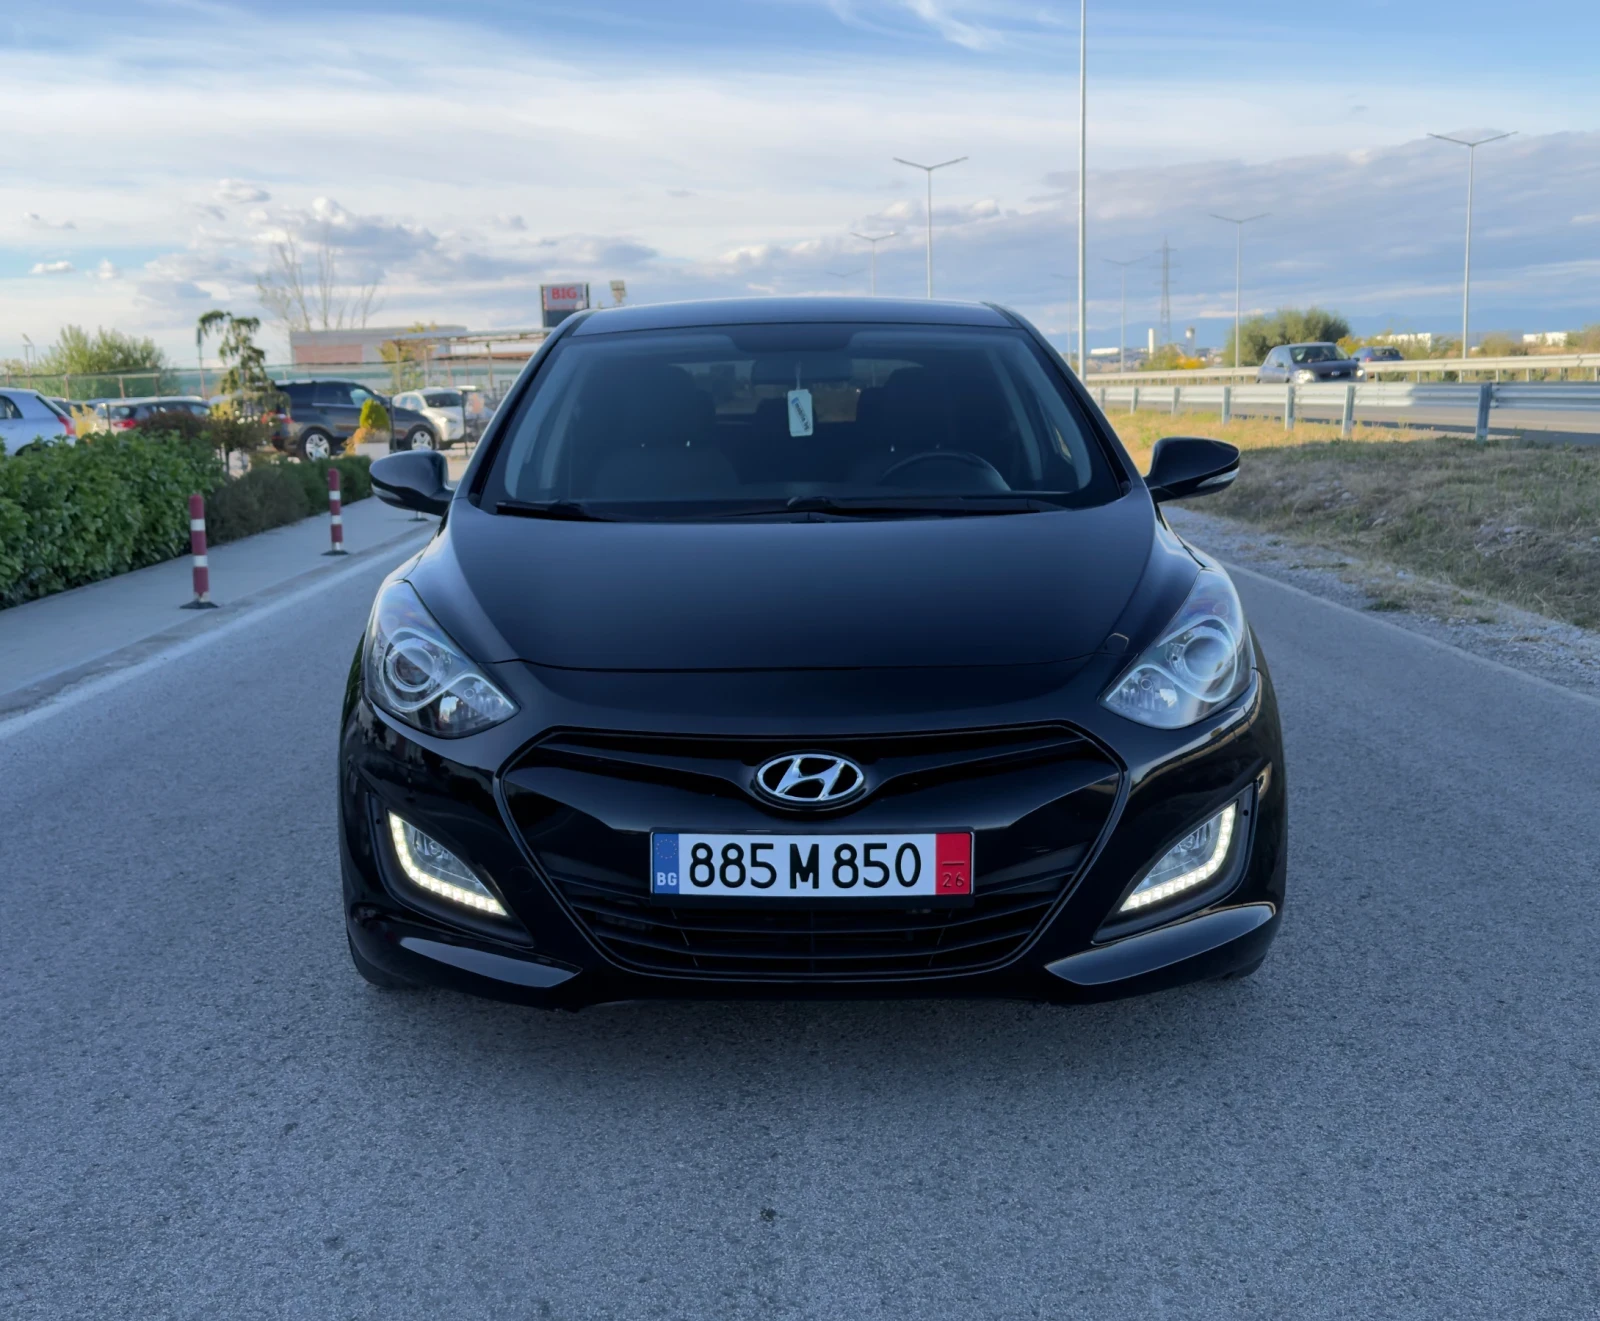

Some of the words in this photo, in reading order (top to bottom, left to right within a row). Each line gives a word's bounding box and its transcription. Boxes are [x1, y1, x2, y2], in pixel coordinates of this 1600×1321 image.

[551, 287, 577, 300] BIG
[689, 842, 778, 889] 885
[789, 843, 820, 889] M
[831, 842, 922, 888] 850
[656, 872, 677, 886] BG
[942, 871, 965, 888] 26
